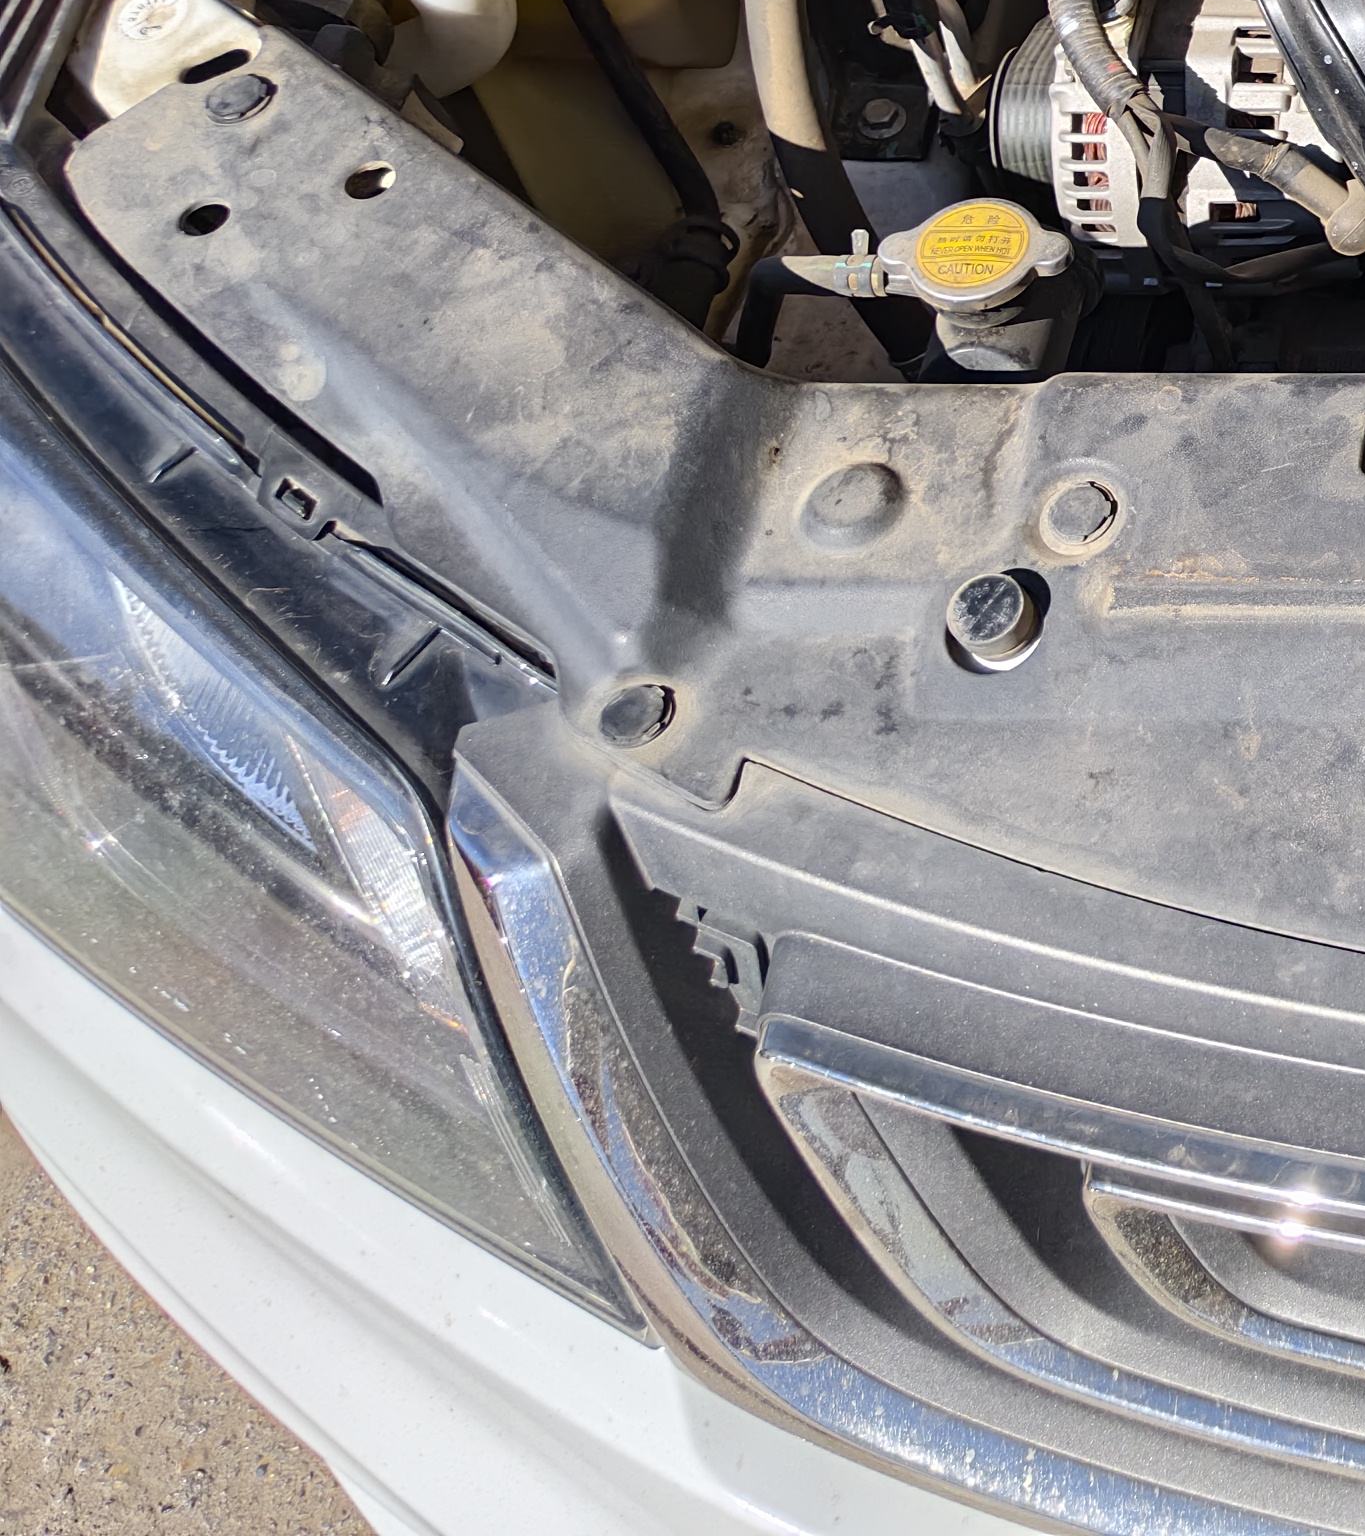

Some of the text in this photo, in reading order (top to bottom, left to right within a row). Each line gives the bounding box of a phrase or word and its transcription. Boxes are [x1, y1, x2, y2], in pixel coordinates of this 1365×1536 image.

[931, 245, 1012, 255] NEVER OPEN WHEN HOT
[937, 263, 994, 275] CAUTION
